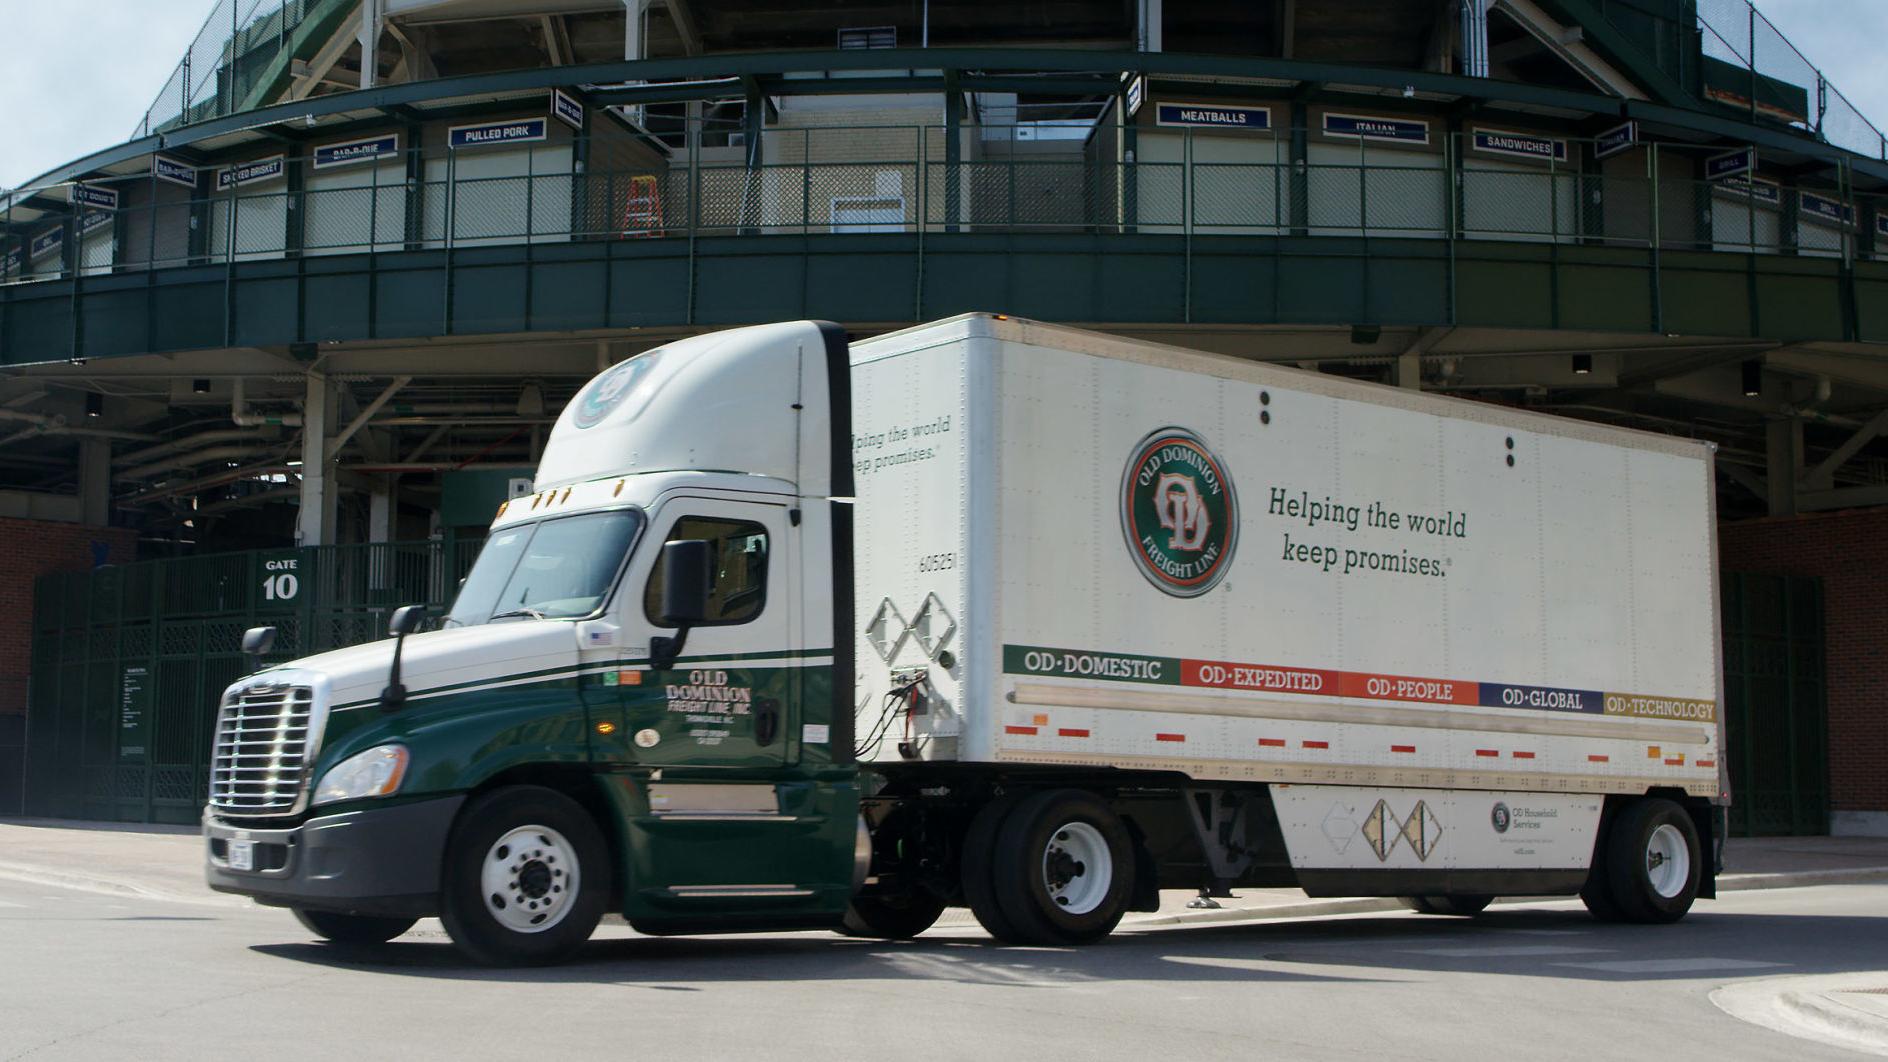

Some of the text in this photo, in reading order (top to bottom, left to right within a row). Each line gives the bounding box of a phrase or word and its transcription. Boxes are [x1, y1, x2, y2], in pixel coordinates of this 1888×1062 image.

[1180, 111, 1246, 123] MEATBALLS
[465, 126, 529, 141] PULLED PORK
[1487, 136, 1551, 153] SANDWICHES
[888, 425, 908, 443] the
[912, 415, 951, 437] world
[1138, 446, 1221, 495] OLD DOMINION
[1268, 487, 1467, 538] Helping the world
[1142, 535, 1220, 578] FREIGHT LINE
[1282, 533, 1338, 572] keep
[265, 559, 298, 570] GATE
[263, 573, 298, 600] 10
[689, 669, 728, 686] OLD
[665, 685, 752, 702] DOMINION
